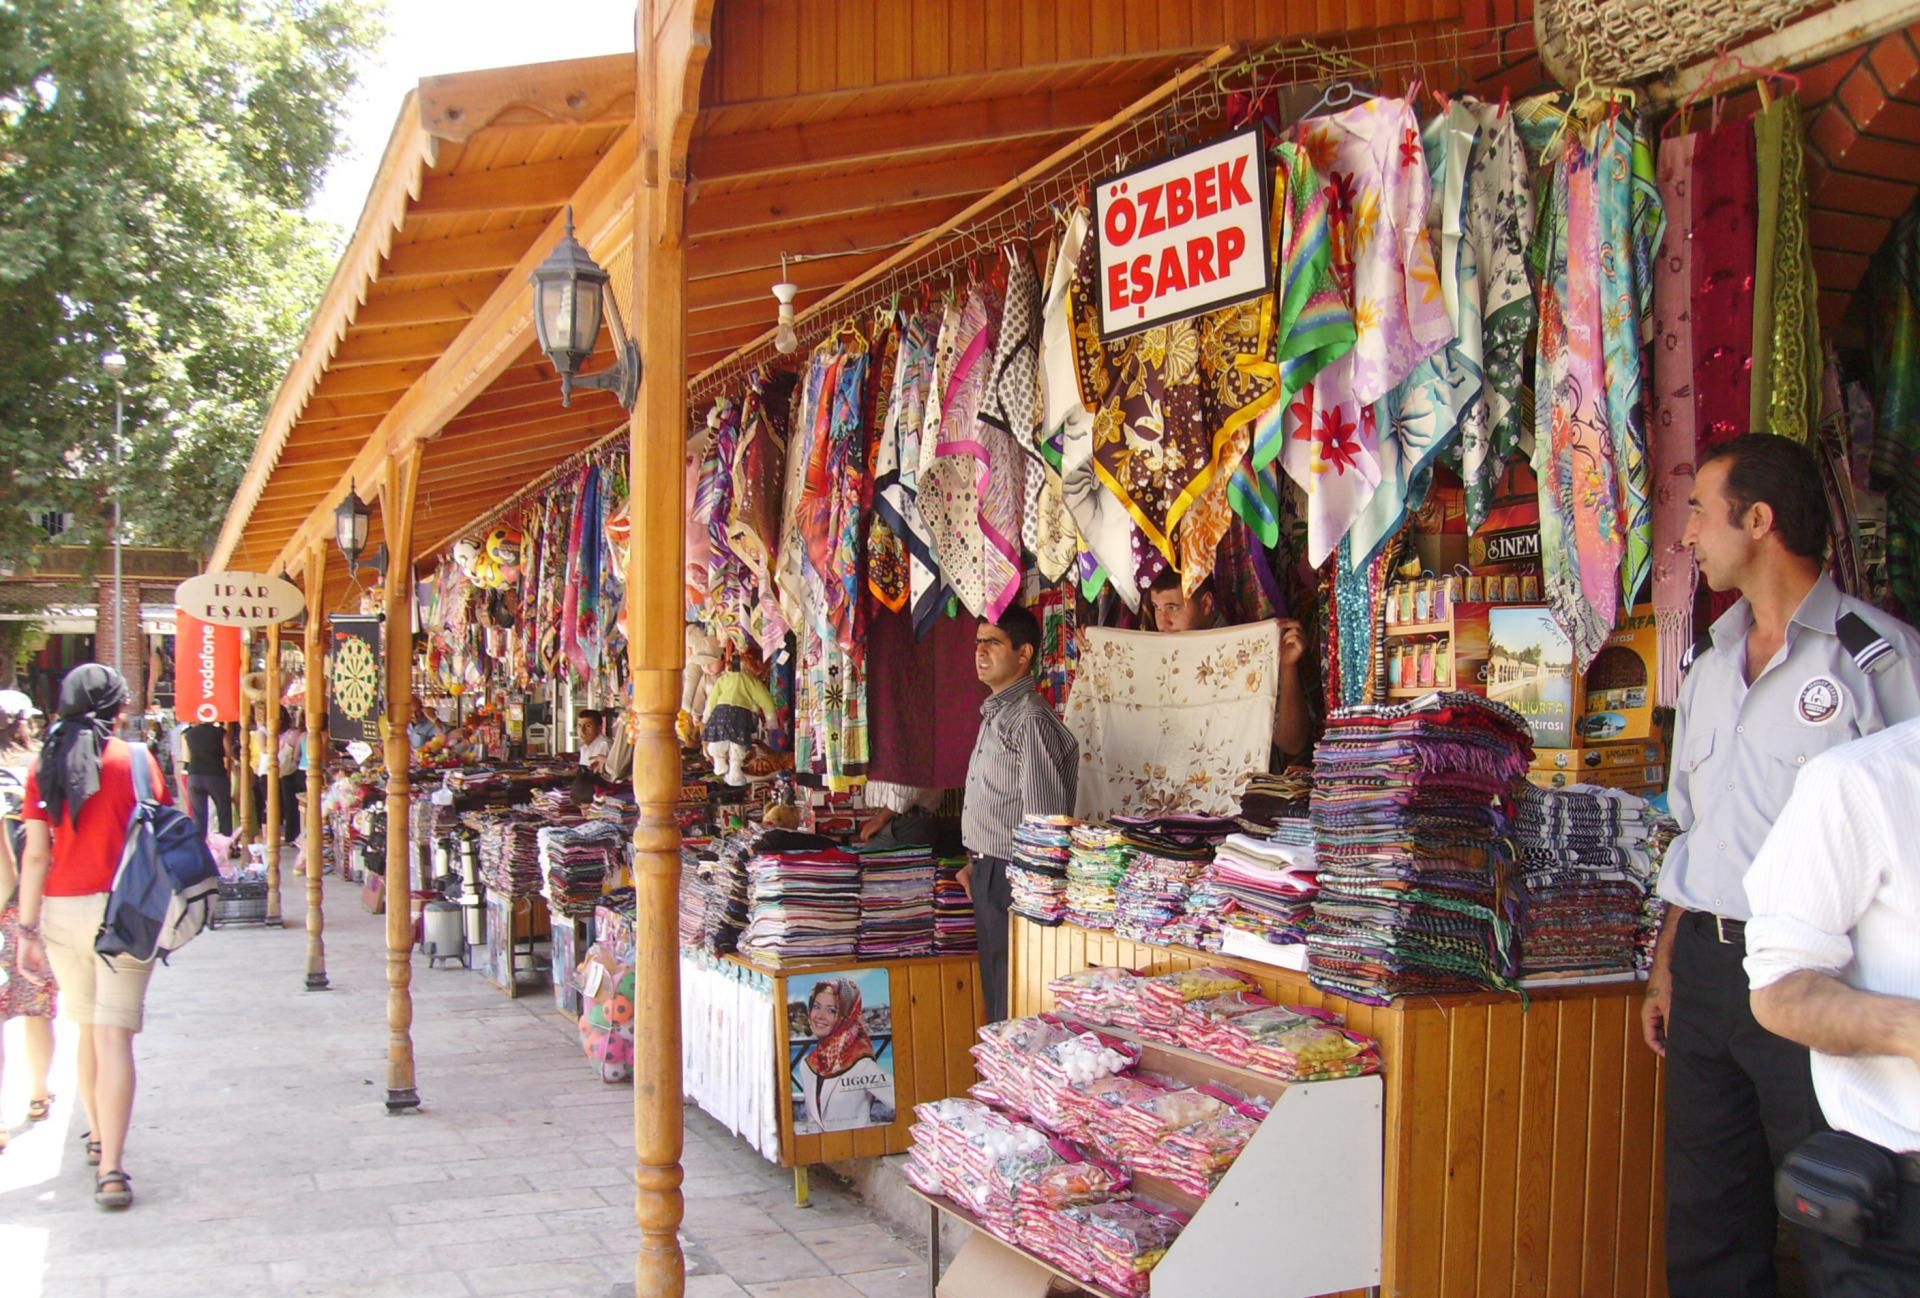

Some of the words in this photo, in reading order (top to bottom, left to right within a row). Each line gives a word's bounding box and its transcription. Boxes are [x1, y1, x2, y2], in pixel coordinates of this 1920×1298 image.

[1105, 155, 1253, 246] ÖZBEK
[1107, 225, 1246, 319] EŞARP
[214, 583, 270, 598] İPAR
[206, 604, 280, 621] EŞARP
[198, 624, 216, 700] vodafone
[1504, 701, 1564, 715] NLIURFA
[840, 1073, 886, 1087] UGOZA
